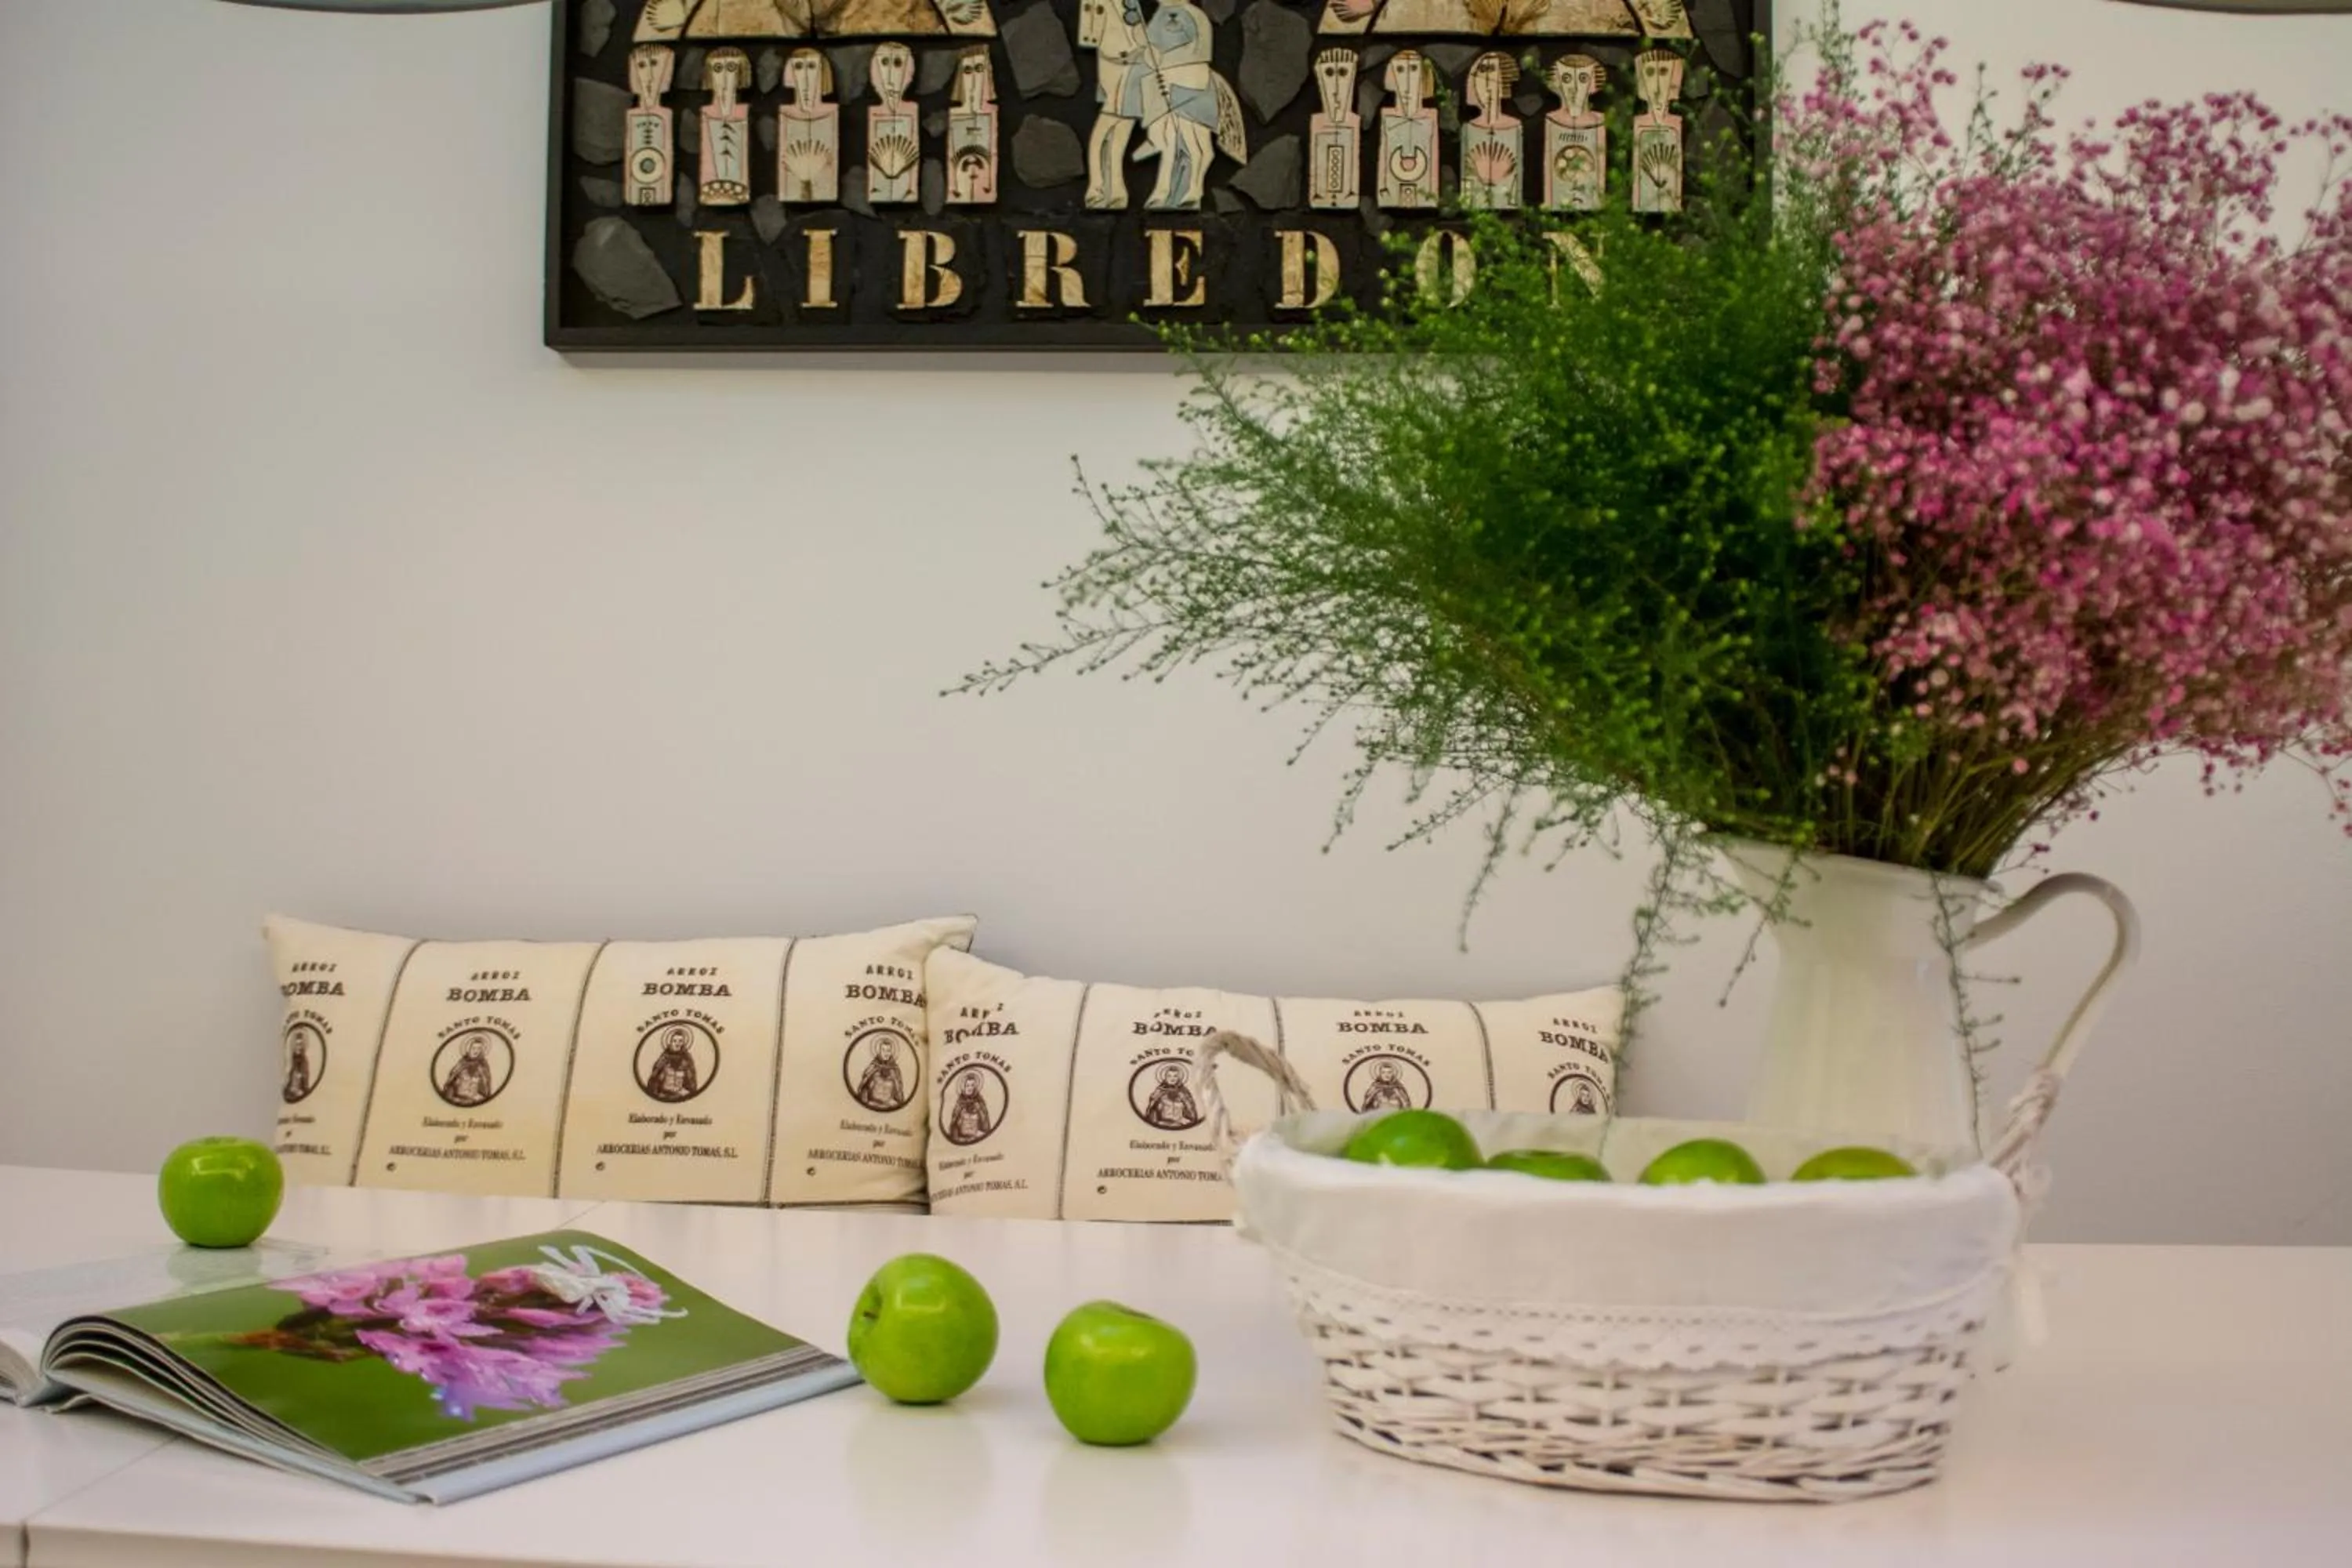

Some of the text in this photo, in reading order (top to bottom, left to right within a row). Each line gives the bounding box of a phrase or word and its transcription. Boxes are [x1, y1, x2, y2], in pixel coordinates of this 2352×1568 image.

[693, 229, 1608, 310] LIBREDON
[446, 987, 532, 1003] BOMBA
[641, 982, 733, 996] BOMBA
[845, 984, 927, 1008] BOMBA
[437, 1015, 521, 1040] SANTO TOMAS
[636, 1008, 725, 1034] SANTO TOMAS
[844, 1016, 885, 1038] SANTO
[1337, 1022, 1429, 1034] BOMBA
[1341, 1044, 1430, 1067] SANTO TOMAS
[1538, 1031, 1608, 1064] BOMBA
[937, 1051, 1012, 1084] SANTO TOMAS
[1548, 1062, 1581, 1080] SANTO
